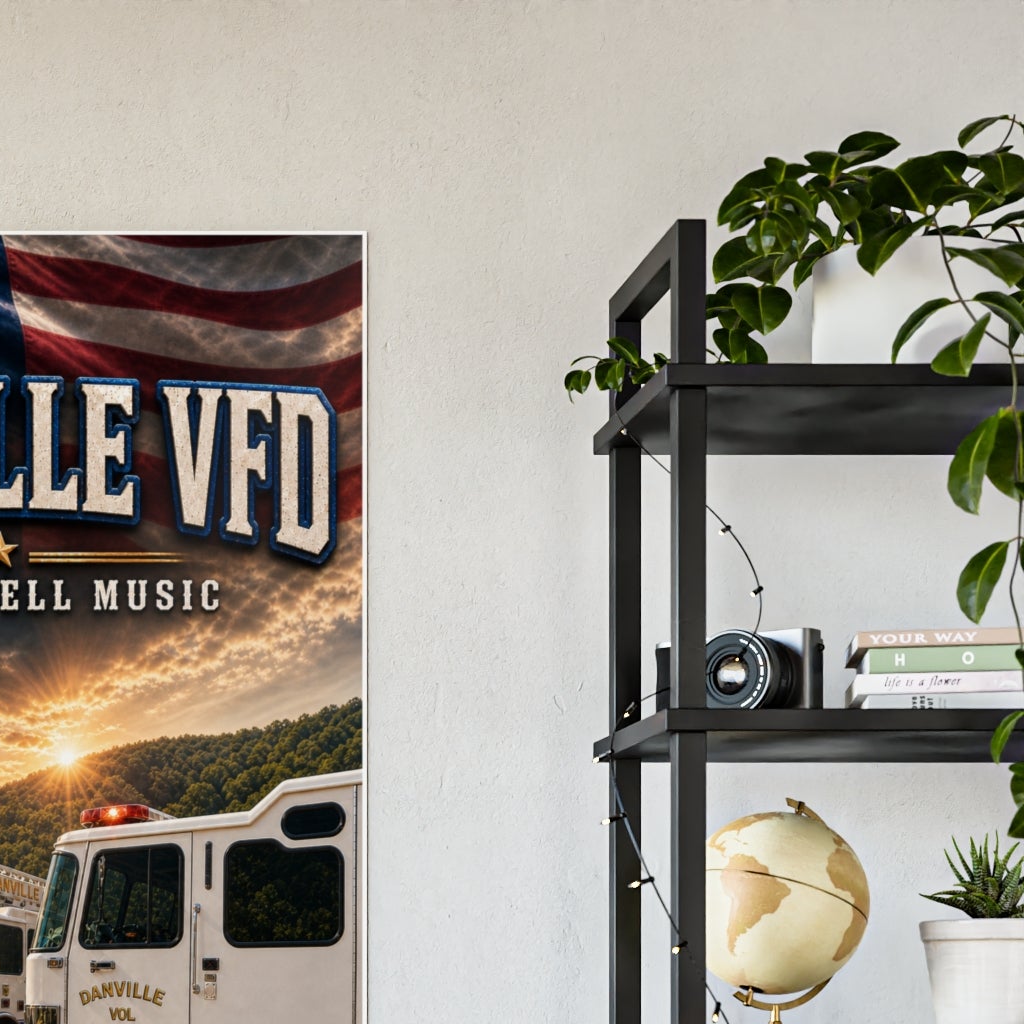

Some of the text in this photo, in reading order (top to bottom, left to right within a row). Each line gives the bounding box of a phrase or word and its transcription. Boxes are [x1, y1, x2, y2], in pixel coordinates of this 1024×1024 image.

[157, 380, 334, 566] VFD
[94, 579, 221, 612] MUSIC
[870, 631, 978, 645] YOUR WAY
[894, 653, 906, 667] H
[884, 675, 963, 690] life is a flower
[79, 981, 166, 1007] DANVILLE
